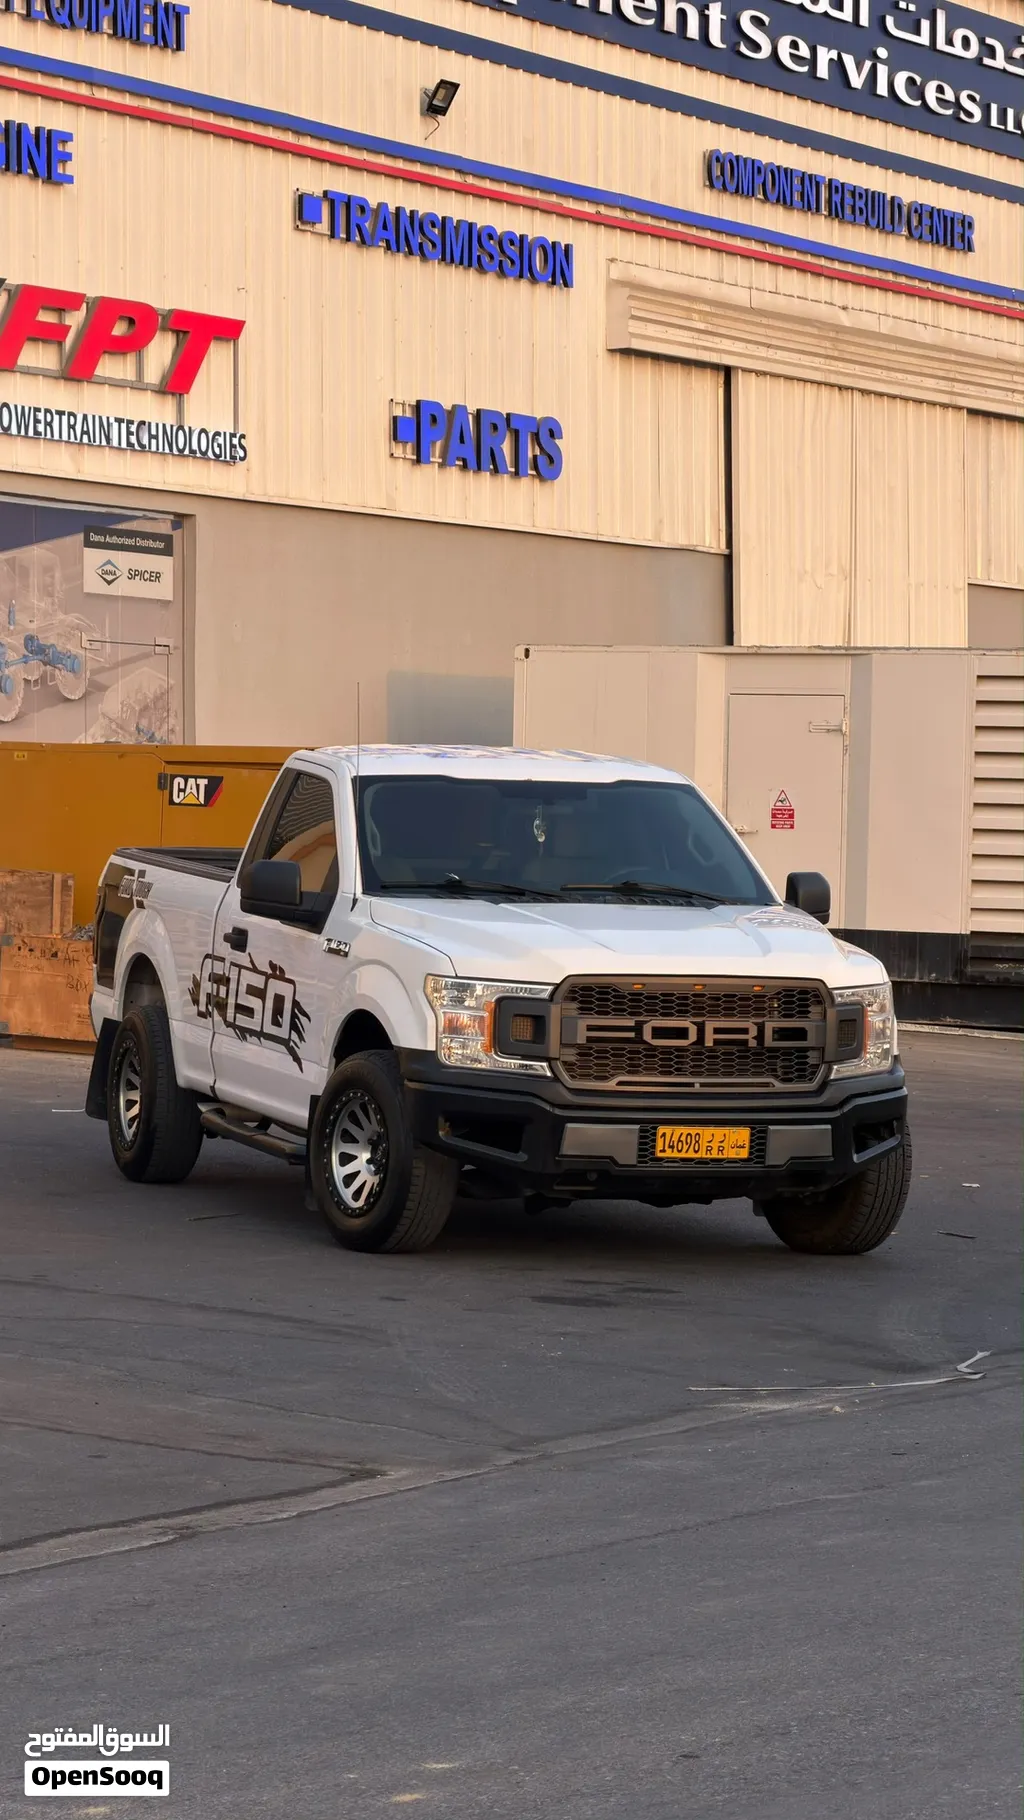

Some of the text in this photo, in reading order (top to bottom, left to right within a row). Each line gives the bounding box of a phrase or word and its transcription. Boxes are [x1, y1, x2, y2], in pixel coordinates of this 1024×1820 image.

[737, 9, 982, 124] Services
[989, 102, 1024, 138] LL
[0, 120, 74, 184] INE
[708, 149, 975, 252] COMPONENT REBUILD CENTER
[323, 189, 574, 288] TRANSMISSION
[0, 284, 246, 394] FPT
[114, 417, 248, 462] TECHNOLOGIES
[416, 399, 563, 480] PARTS
[89, 532, 165, 549] Dana Authorized Distributor
[101, 567, 162, 583] DANA SPICER
[172, 776, 209, 804] CAT
[577, 1018, 809, 1048] FORD
[659, 1130, 701, 1154] 14698
